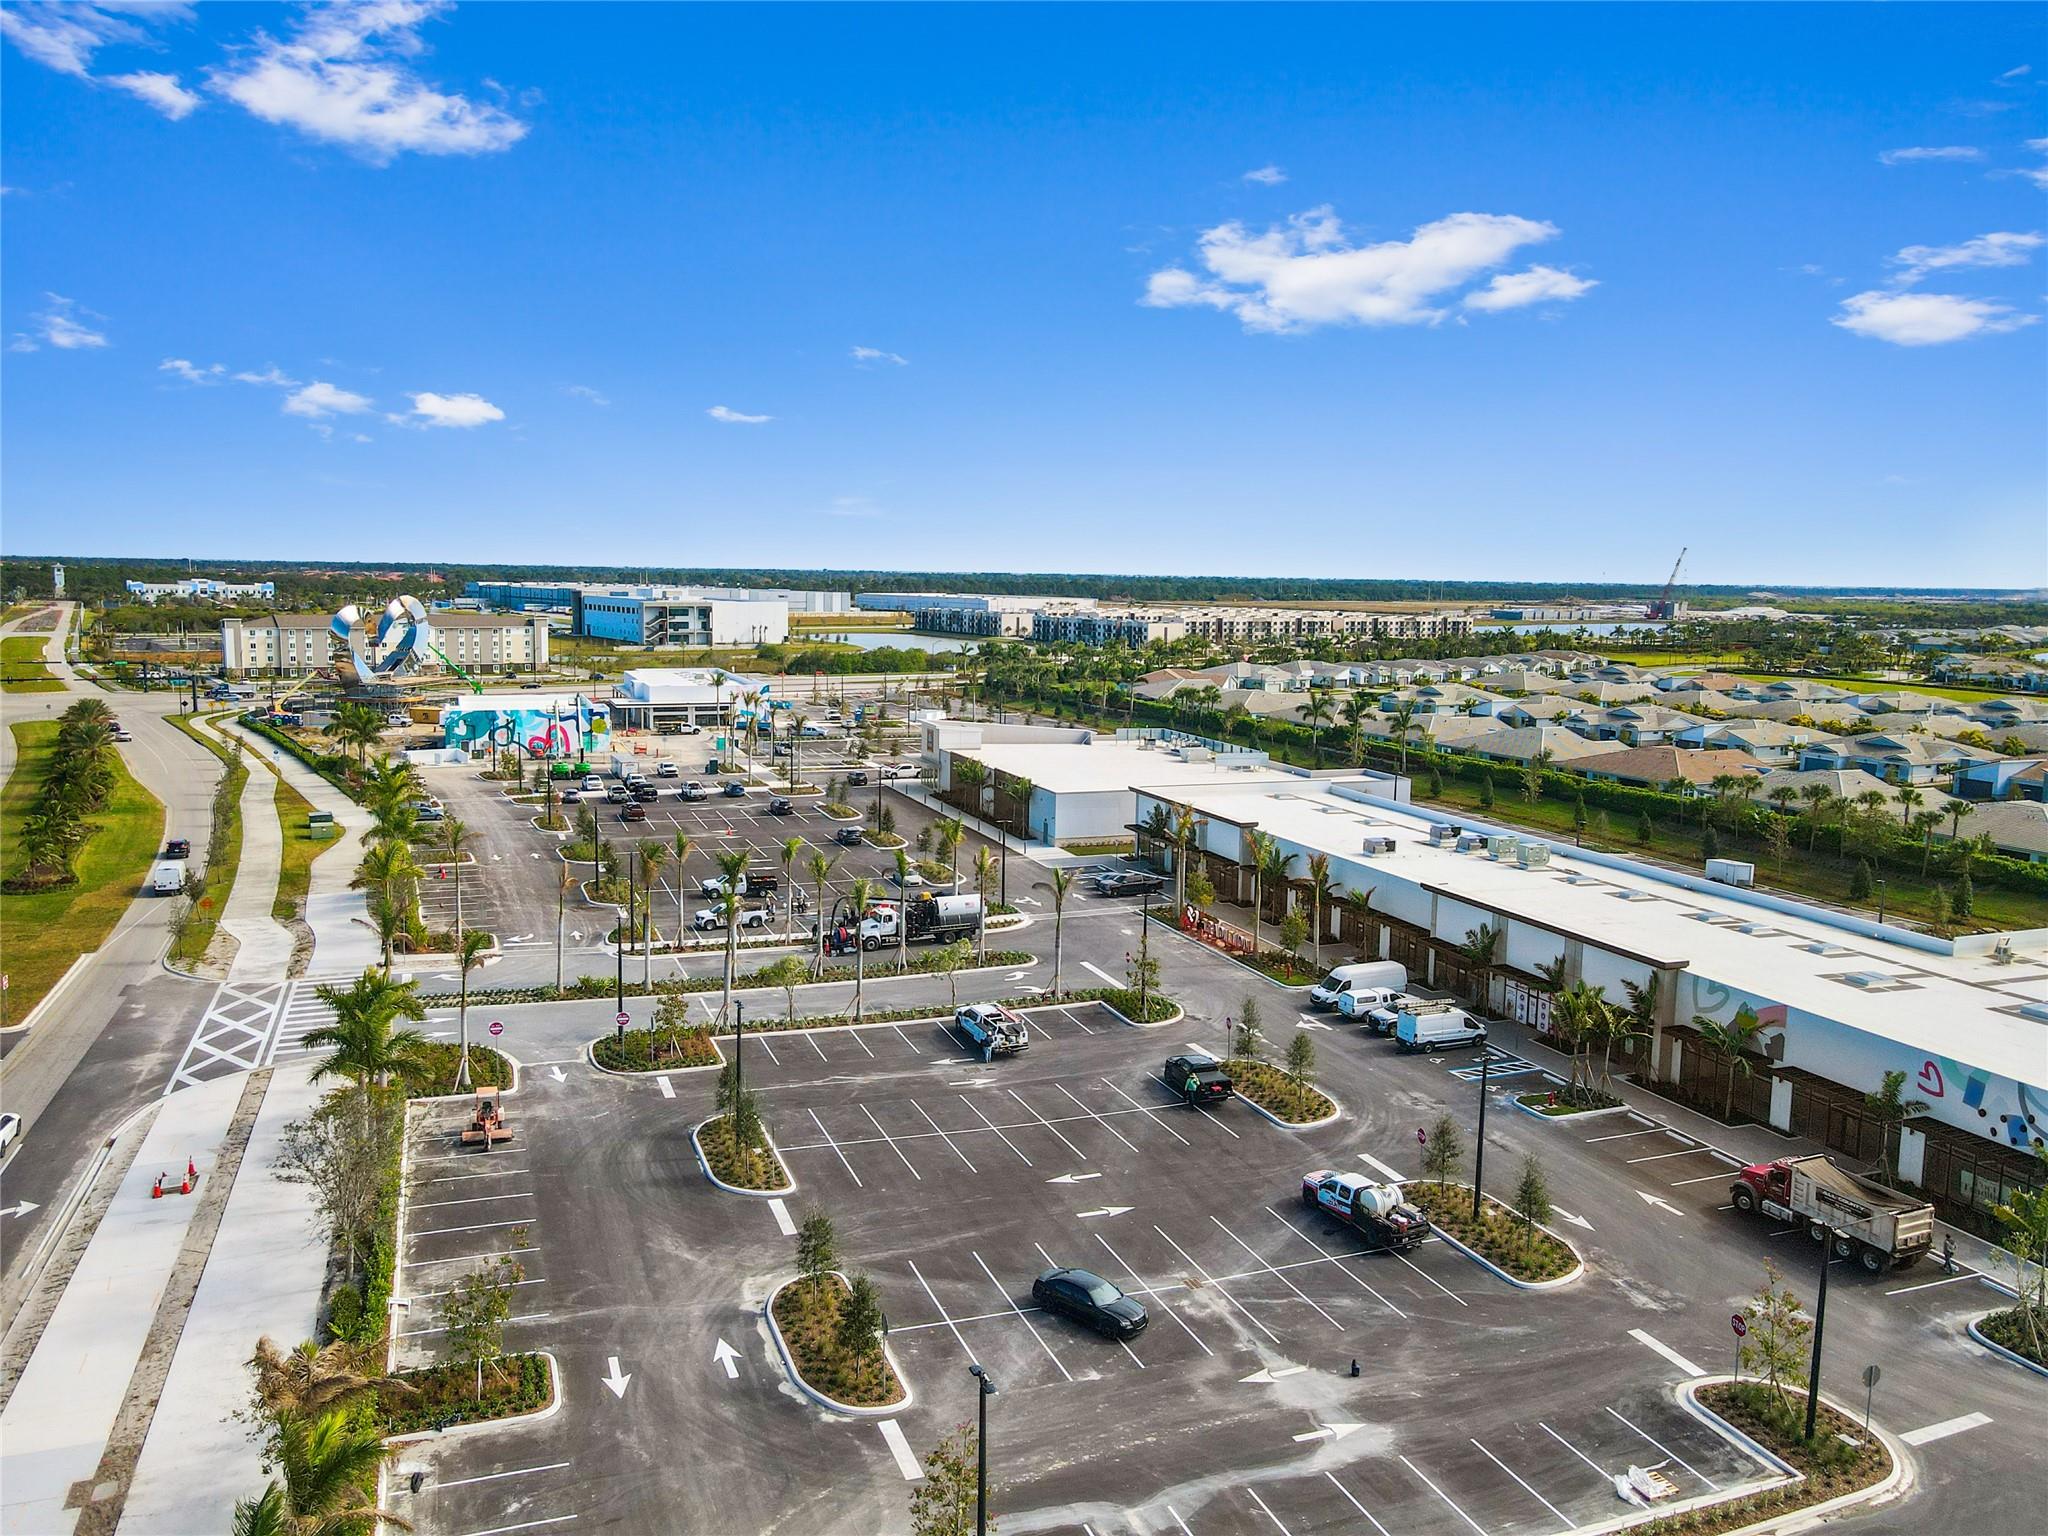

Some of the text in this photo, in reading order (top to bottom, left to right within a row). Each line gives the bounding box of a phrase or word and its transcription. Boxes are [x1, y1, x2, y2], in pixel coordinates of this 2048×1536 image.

[1822, 1190, 1837, 1200] ALL
[1838, 1196, 1865, 1211] COUNTY
[1732, 1317, 1746, 1333] STOP
